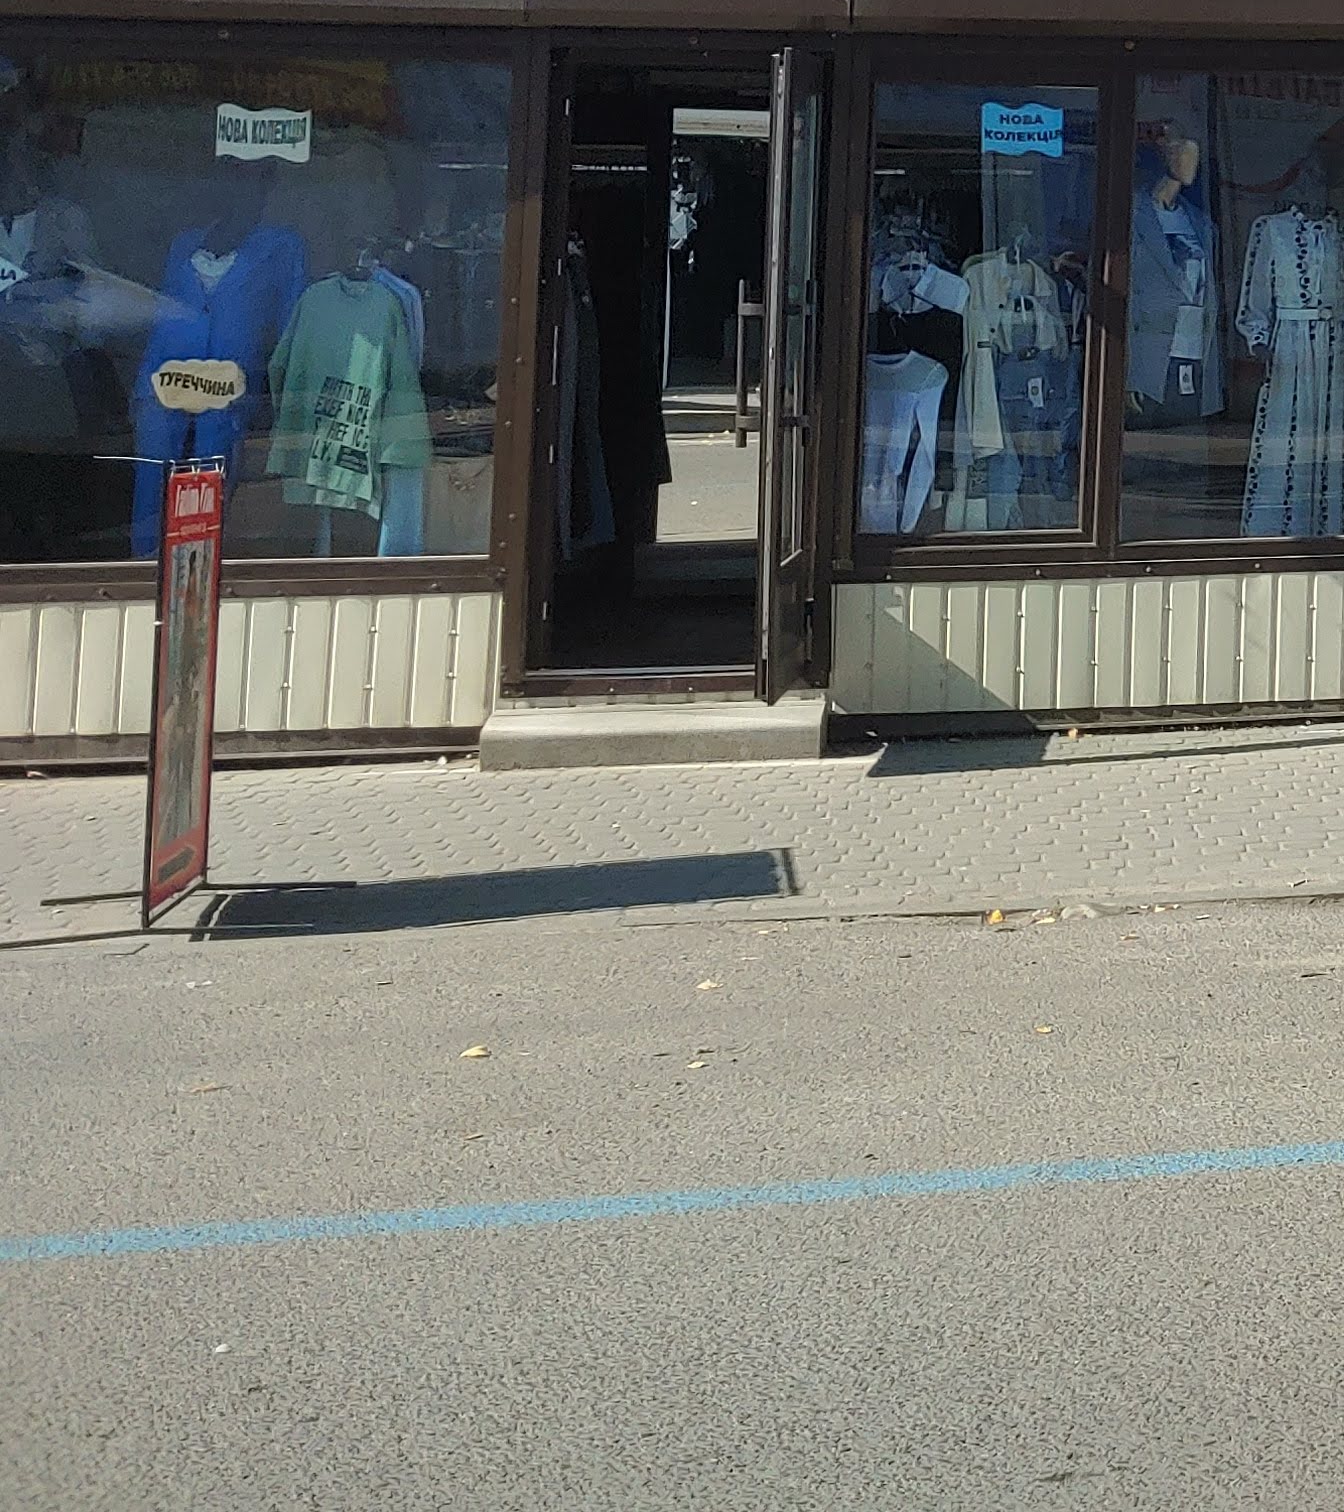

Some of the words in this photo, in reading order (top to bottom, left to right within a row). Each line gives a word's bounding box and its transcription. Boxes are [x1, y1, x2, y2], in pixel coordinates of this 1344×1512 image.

[218, 114, 248, 143] НОВА
[999, 113, 1044, 124] НОВА
[159, 372, 235, 396] ТУРЕЧЧИНА
